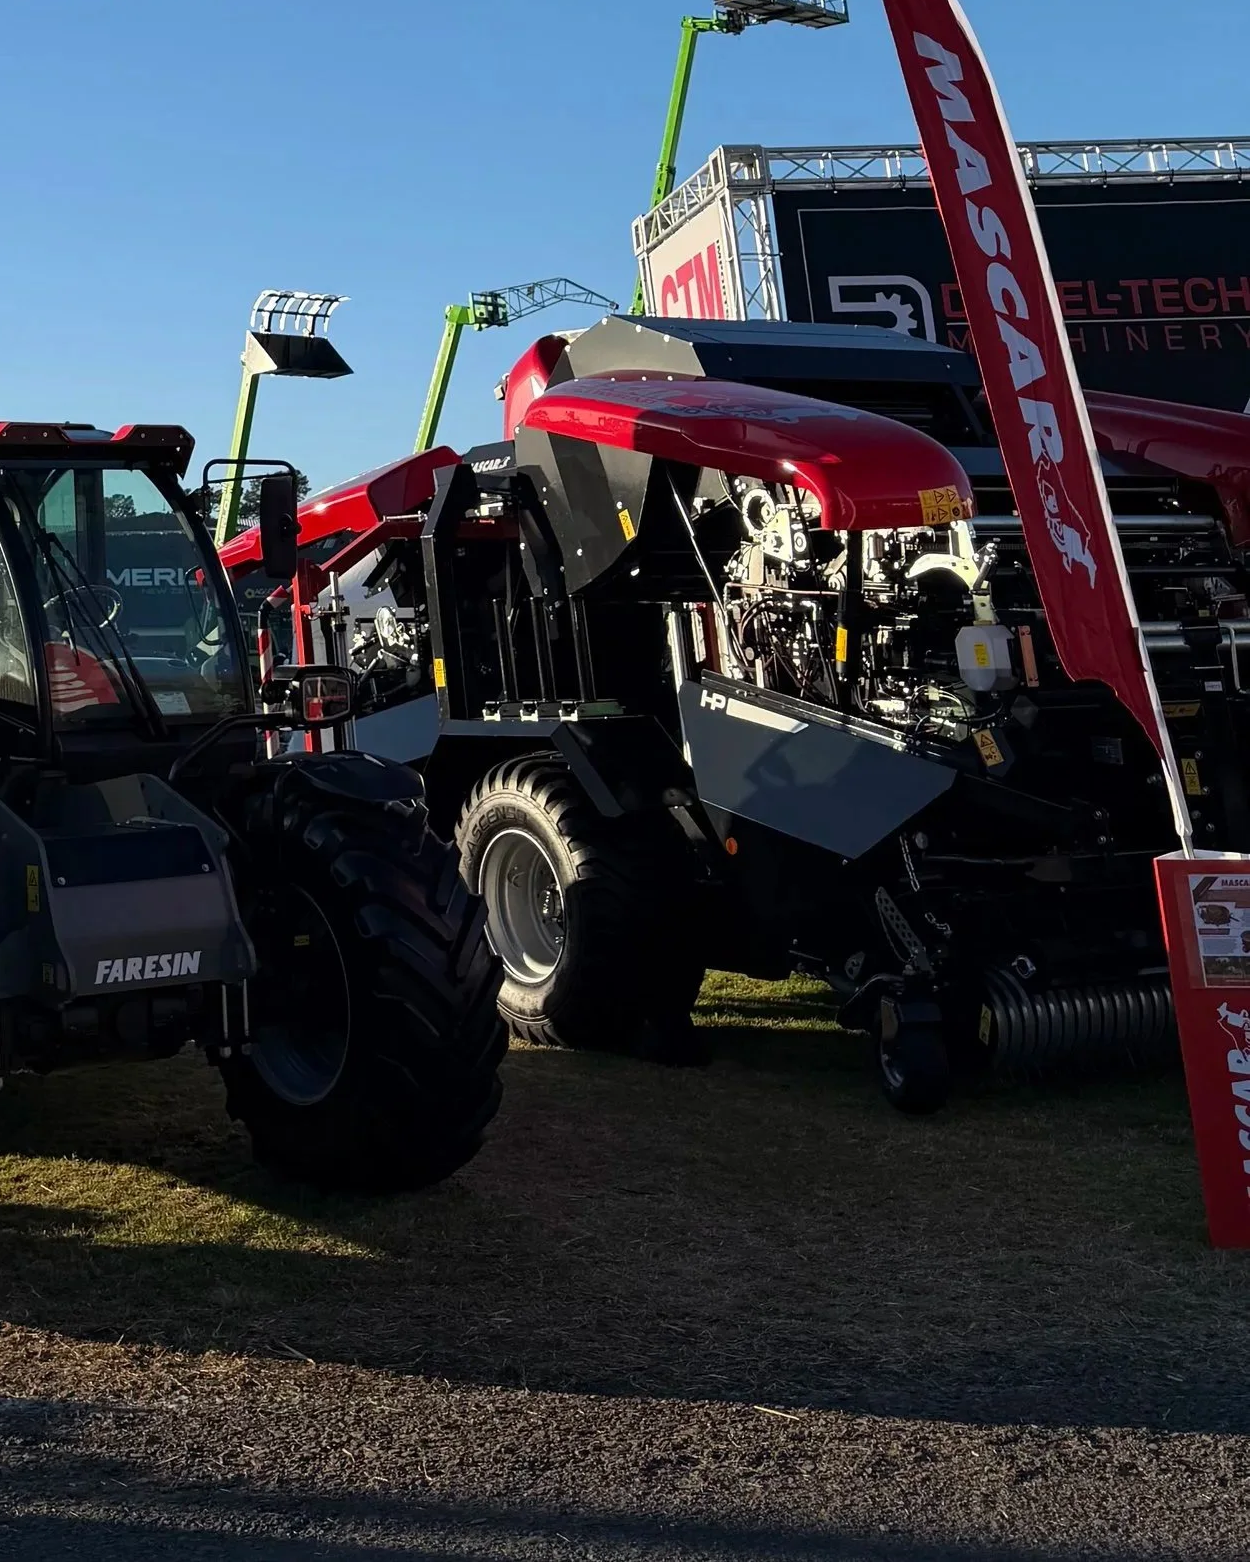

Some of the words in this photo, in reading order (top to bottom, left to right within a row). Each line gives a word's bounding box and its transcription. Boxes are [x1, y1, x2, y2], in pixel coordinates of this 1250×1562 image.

[913, 31, 1064, 465] MASCAR
[470, 458, 501, 474] ASCAR
[700, 688, 726, 711] HP
[94, 950, 202, 985] FARESIN
